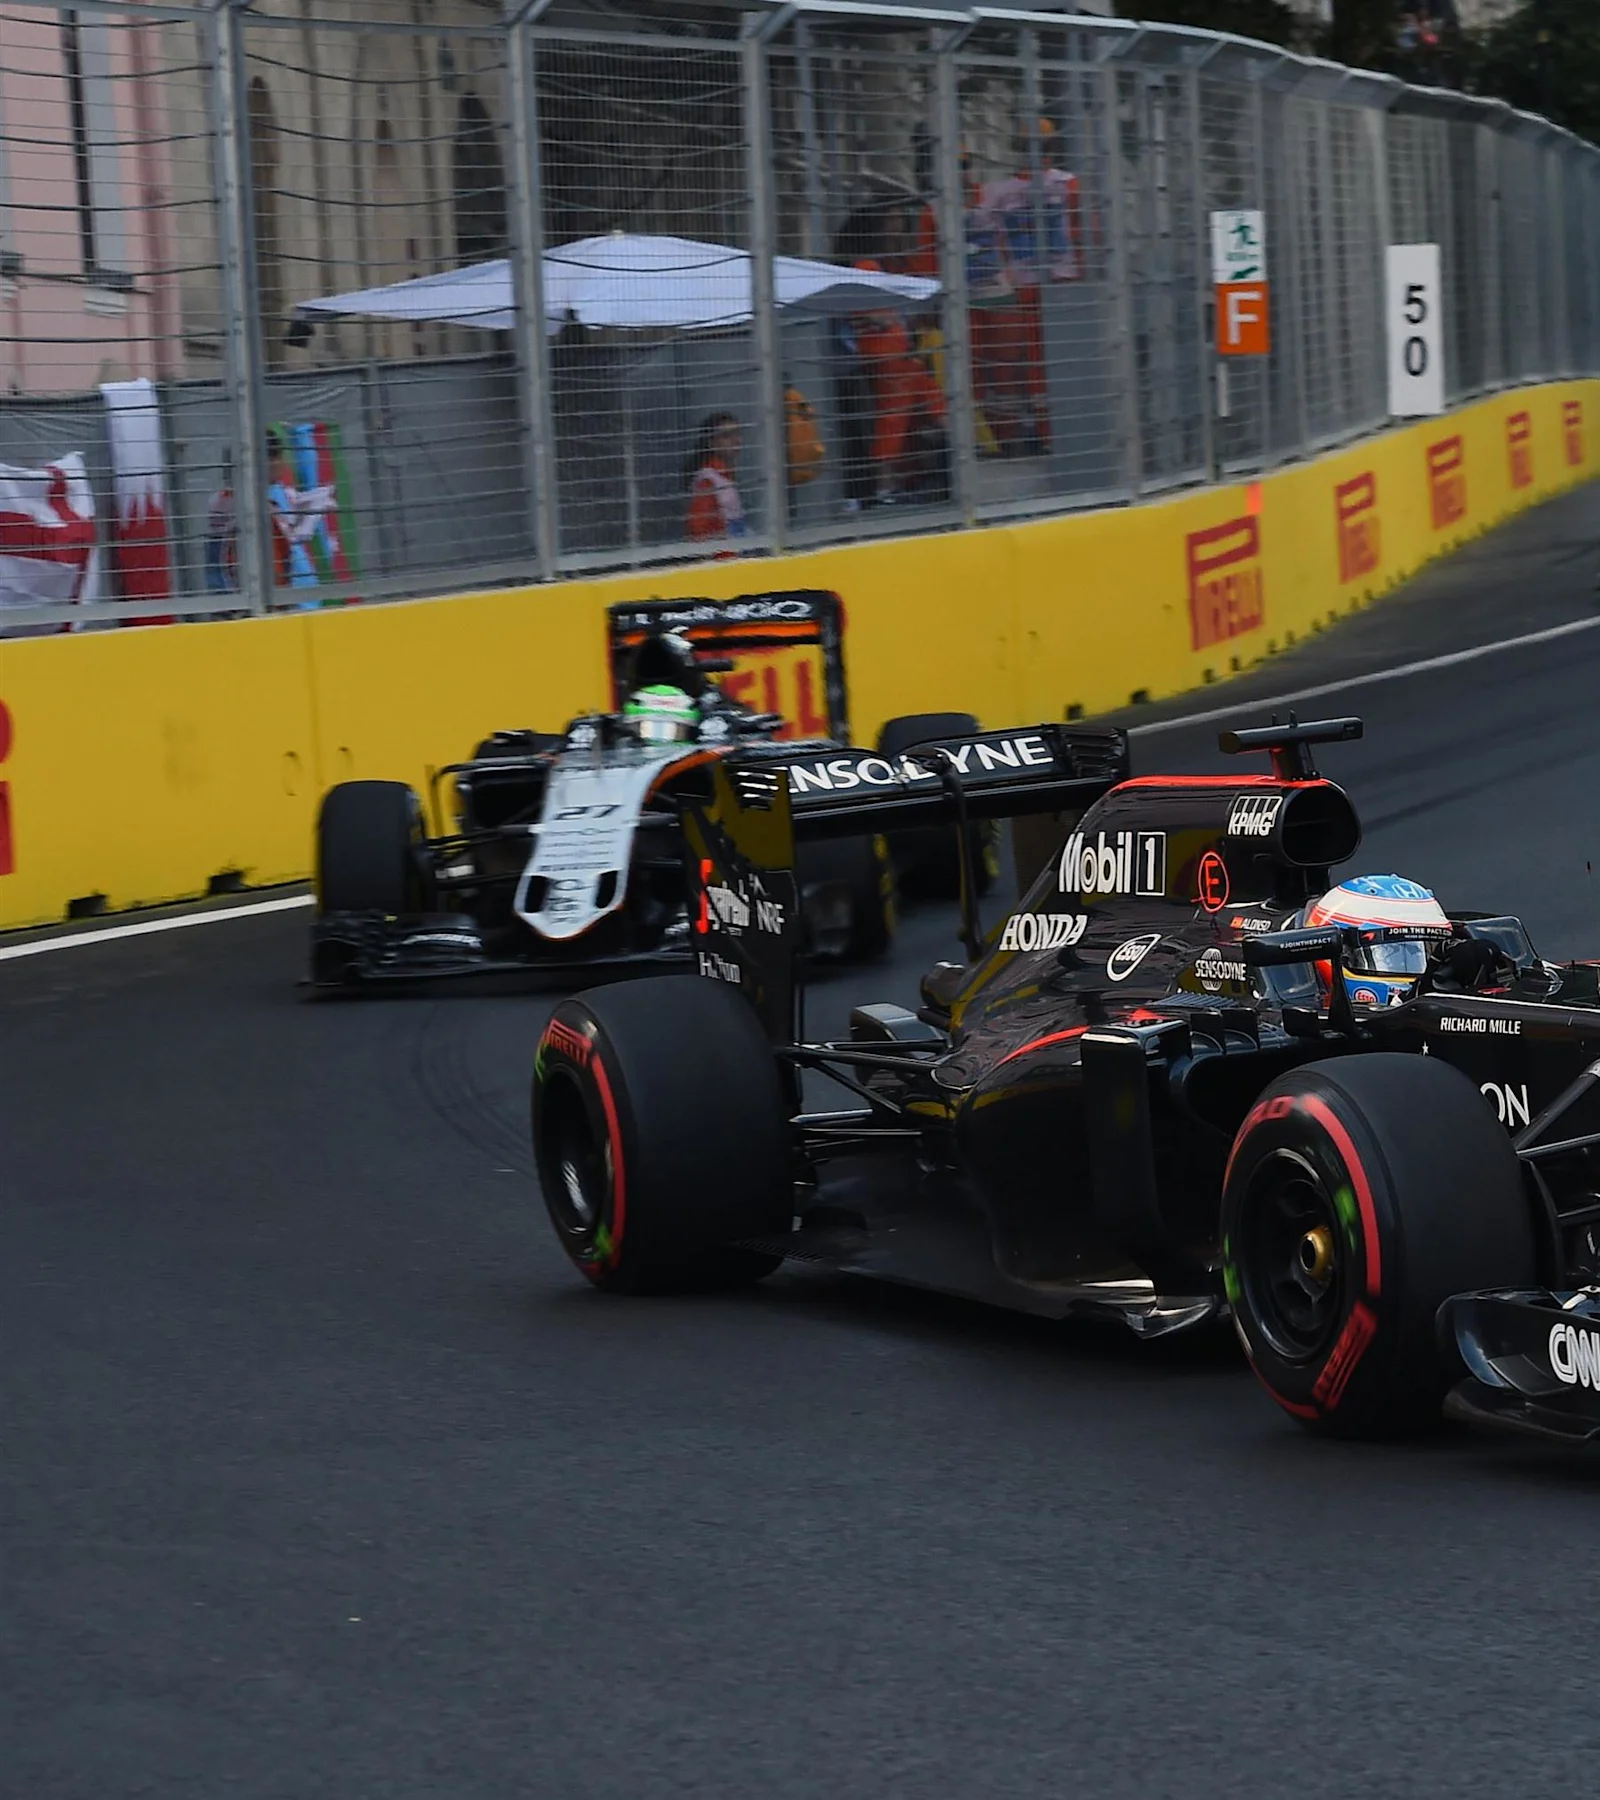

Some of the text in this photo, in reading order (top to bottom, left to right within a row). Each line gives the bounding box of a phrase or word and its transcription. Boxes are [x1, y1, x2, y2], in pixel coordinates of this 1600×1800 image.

[1227, 291, 1262, 345] F
[1405, 284, 1428, 377] 50
[1228, 812, 1274, 836] KPMG
[1058, 831, 1133, 894] Mobil
[1000, 912, 1088, 952] HONDA
[1242, 918, 1272, 932] ALONSO
[1388, 927, 1409, 936] JOIN
[1411, 927, 1426, 935] THE
[1195, 959, 1248, 981] SENSODYNE
[1440, 1017, 1522, 1035] RICHARD MILLE
